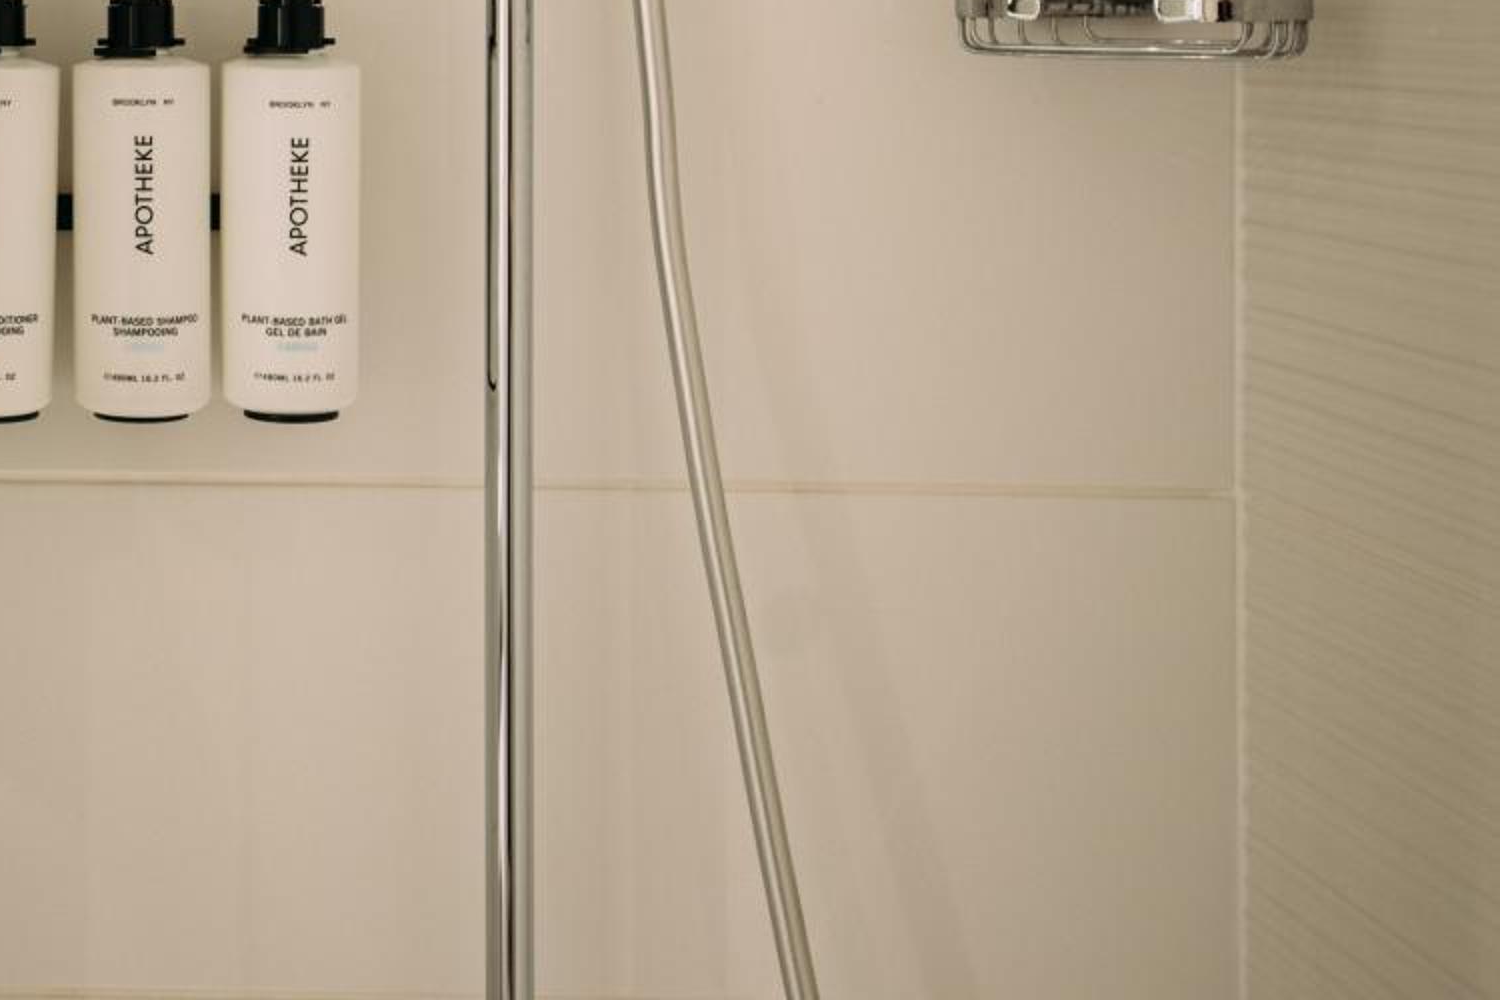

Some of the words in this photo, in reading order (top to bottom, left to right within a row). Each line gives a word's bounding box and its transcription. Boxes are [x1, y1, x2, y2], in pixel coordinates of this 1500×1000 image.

[134, 135, 155, 255] APOTHEKE
[290, 137, 311, 256] APOTHEKE
[91, 313, 154, 326] PLANT-BASED
[156, 313, 198, 326] SHAMPOO
[241, 313, 307, 327] PLANT-BASED
[308, 315, 333, 326] BATH
[113, 327, 179, 337] SHAMPOOING
[265, 327, 284, 337] GEL
[287, 327, 300, 337] DE
[304, 327, 327, 337] BAIN
